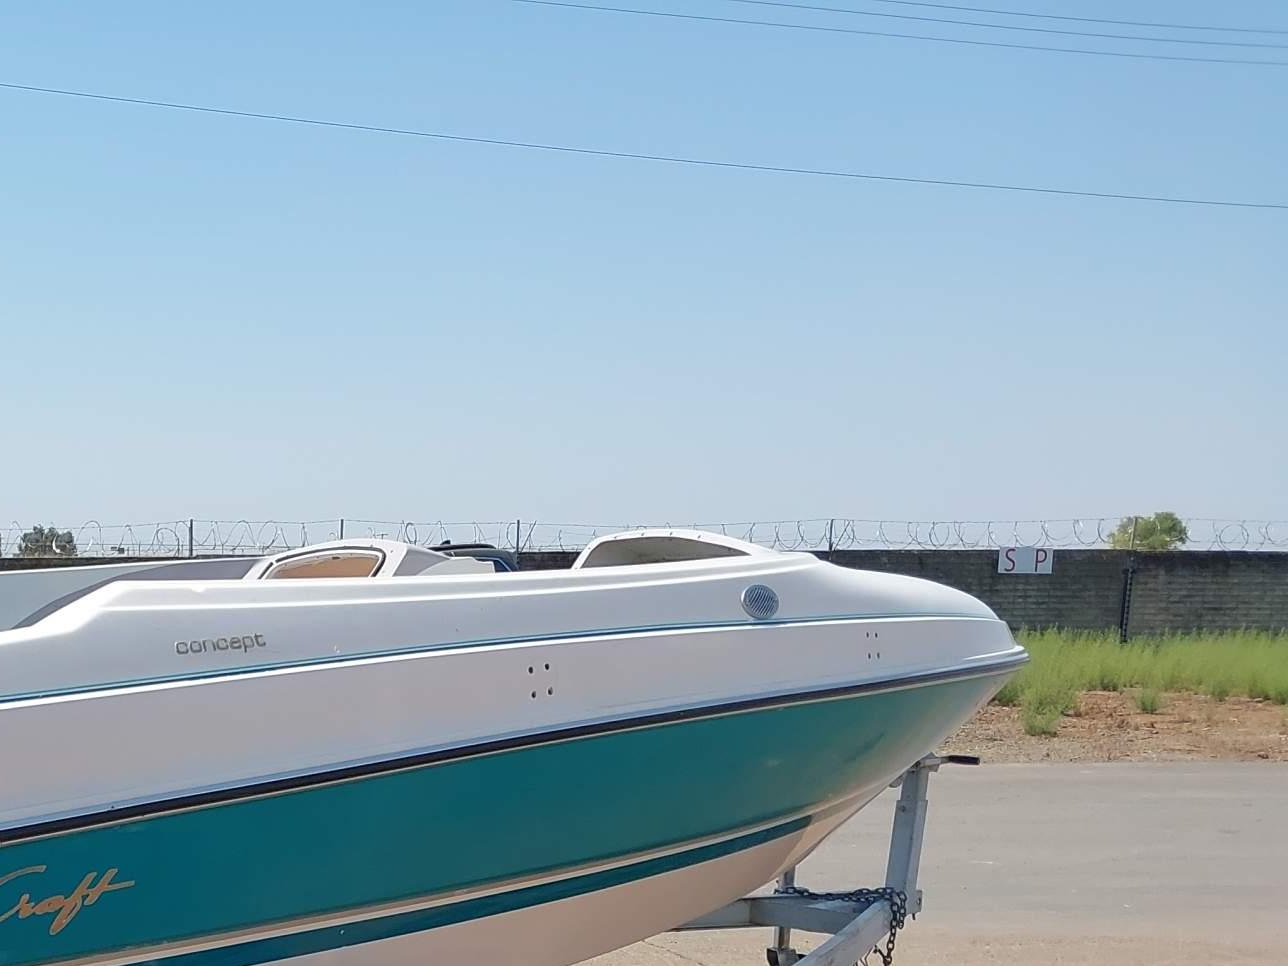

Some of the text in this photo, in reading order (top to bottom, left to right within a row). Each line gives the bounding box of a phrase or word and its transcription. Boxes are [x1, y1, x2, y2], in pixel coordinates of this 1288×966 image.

[1004, 548, 1047, 572] S P
[175, 633, 267, 654] concept
